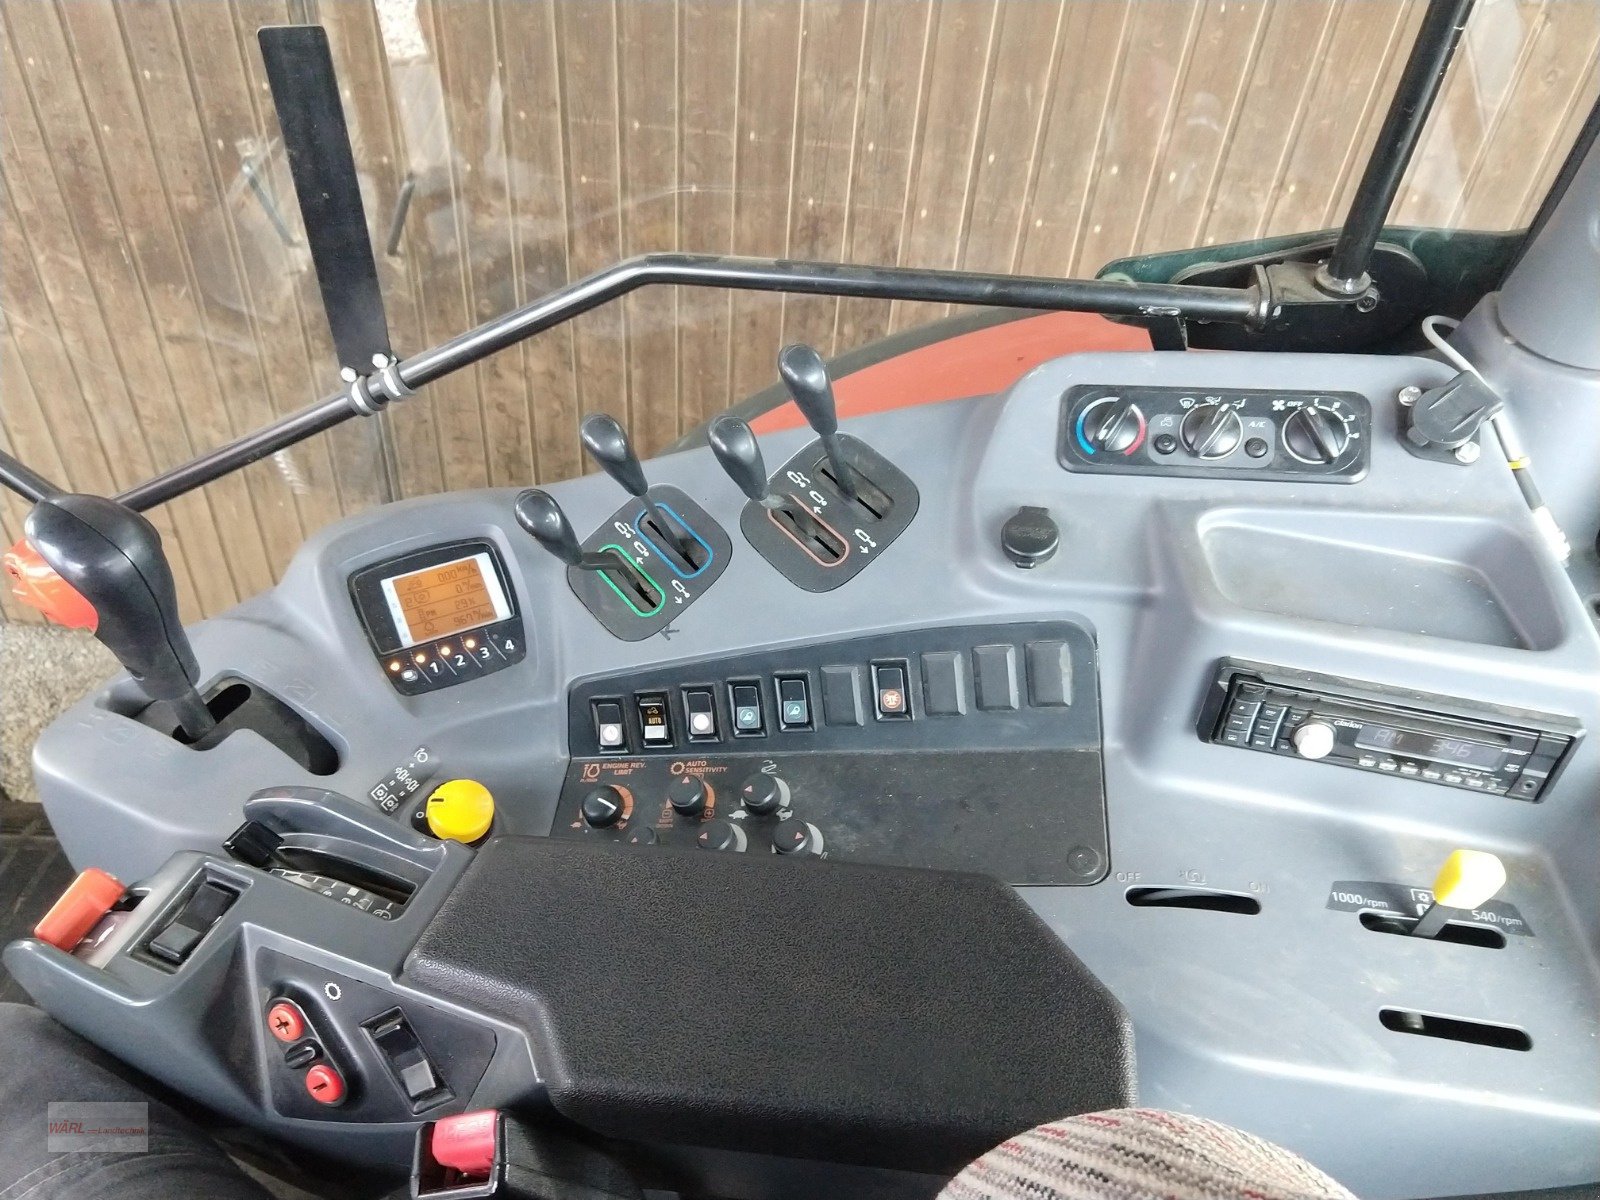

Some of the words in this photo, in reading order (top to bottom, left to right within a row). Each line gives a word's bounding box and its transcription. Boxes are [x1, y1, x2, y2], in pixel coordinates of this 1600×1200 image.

[1247, 420, 1266, 428] A/C
[429, 661, 439, 673] 1
[454, 654, 466, 666] 2
[479, 647, 490, 659] 3
[505, 639, 515, 651] 4
[1333, 718, 1363, 729] clarion
[1373, 729, 1404, 744] AM
[629, 761, 647, 769] REV.
[613, 768, 633, 776] LIMIT
[1115, 872, 1142, 883] OFF
[1331, 891, 1389, 908] 1000/rpm
[1471, 909, 1523, 927] 540/rpm
